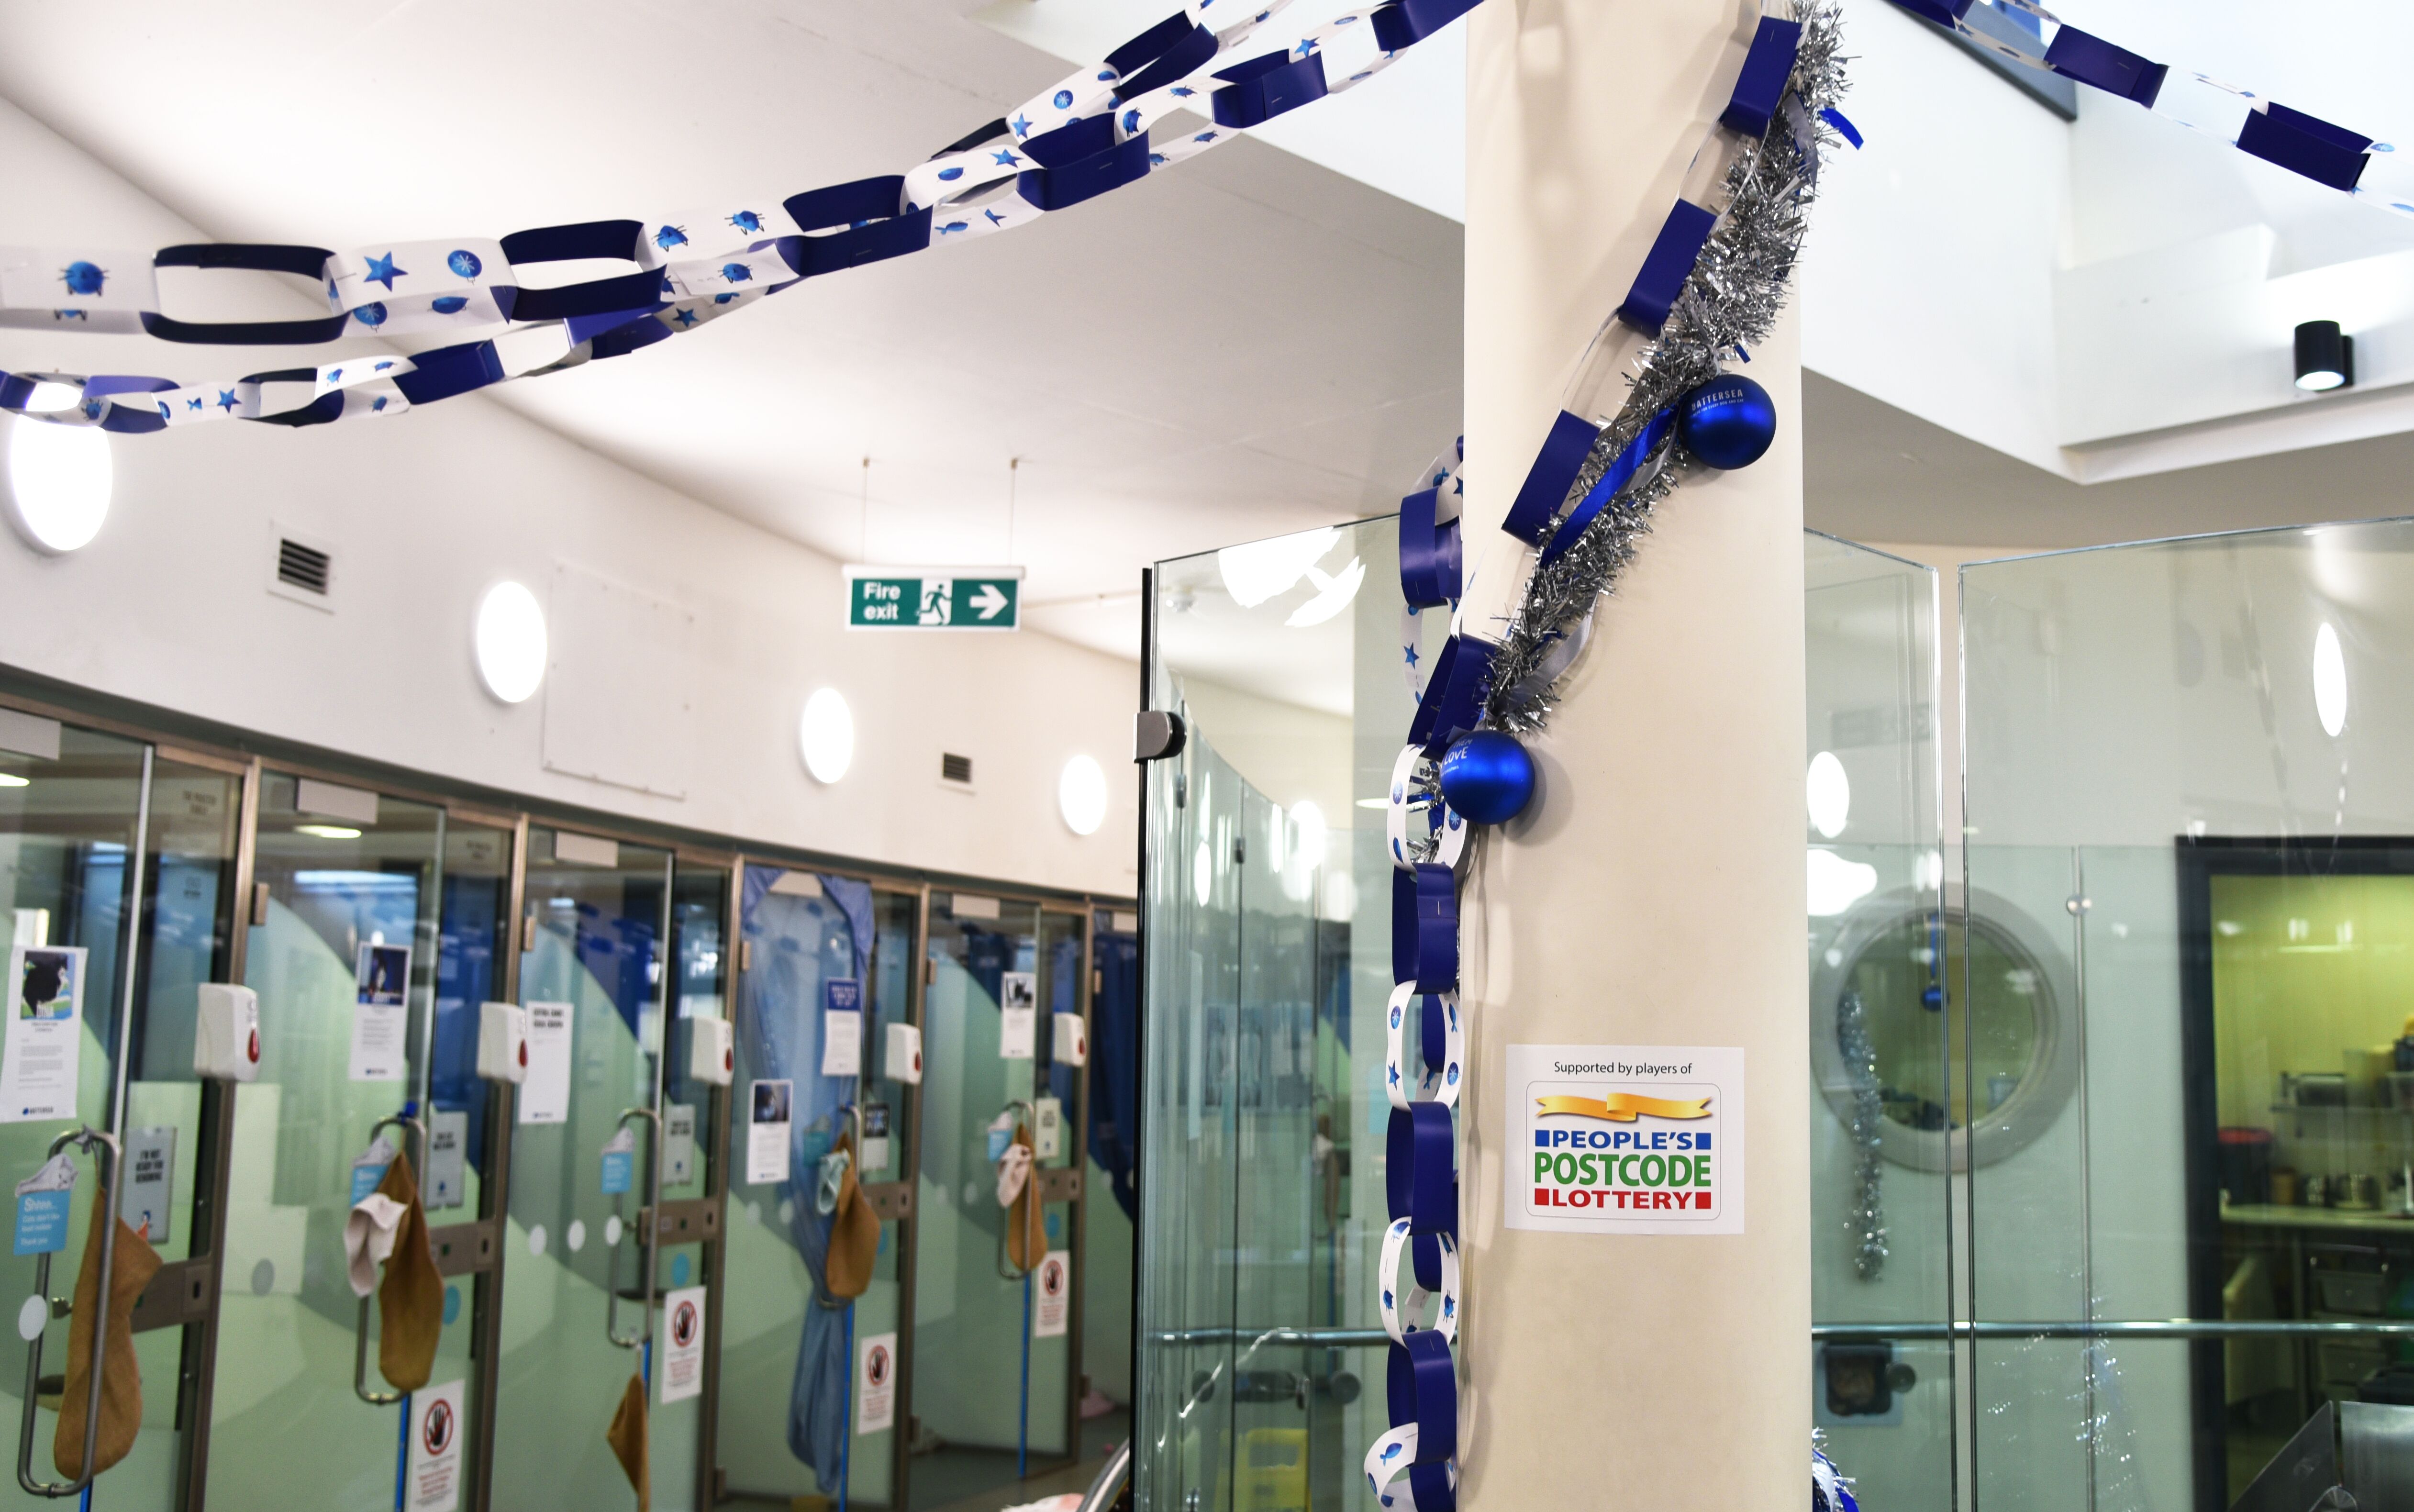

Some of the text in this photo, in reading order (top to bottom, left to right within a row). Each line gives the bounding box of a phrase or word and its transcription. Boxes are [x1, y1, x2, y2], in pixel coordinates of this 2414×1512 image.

[1691, 389, 1743, 411] BATTERSEA
[863, 582, 901, 600] Fire
[863, 602, 899, 621] exit
[1444, 746, 1469, 766] LOVE
[1554, 1061, 1692, 1076] Supported by players of
[1553, 1130, 1693, 1150] PEOPLE'S
[1534, 1152, 1712, 1187] POSTCODE
[1552, 1189, 1693, 1210] LOTTERY
